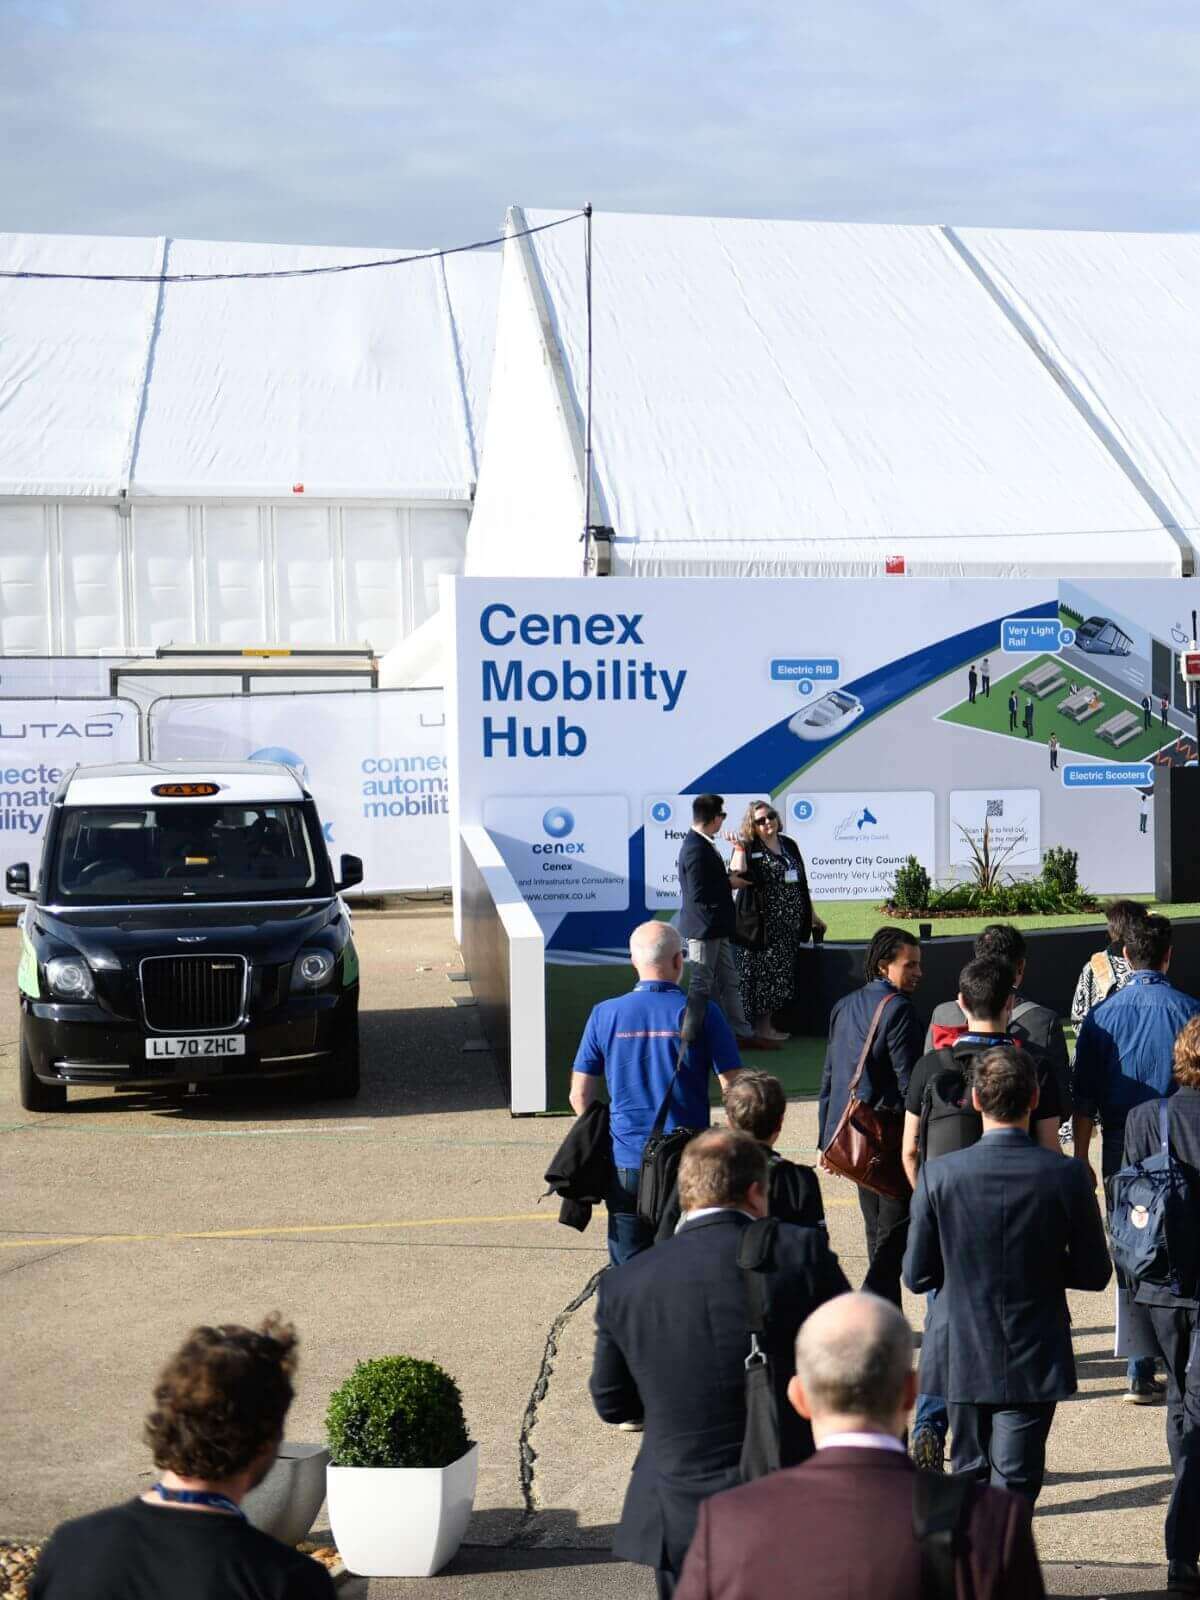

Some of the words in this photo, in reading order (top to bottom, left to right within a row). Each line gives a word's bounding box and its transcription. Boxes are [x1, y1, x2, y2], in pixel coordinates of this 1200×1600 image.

[480, 603, 644, 646] Cenex
[1008, 626, 1029, 637] Very
[1031, 625, 1055, 637] Light
[1008, 637, 1026, 647] Rail
[777, 665, 814, 674] Electric
[815, 664, 833, 674] RIB
[482, 659, 687, 712] Mobility
[483, 716, 587, 758] Hub
[1070, 771, 1104, 781] Electric
[1105, 770, 1145, 780] Scooters
[657, 807, 666, 817] 4
[800, 805, 807, 816] 5
[532, 842, 585, 855] cenex
[811, 856, 853, 867] Coventry
[855, 855, 874, 867] City
[542, 862, 573, 872] Cenex
[810, 871, 849, 881] Coventry
[851, 870, 871, 881] Very
[872, 870, 894, 881] Light
[153, 1040, 199, 1057] LL70
[203, 1037, 238, 1055] ZHC
